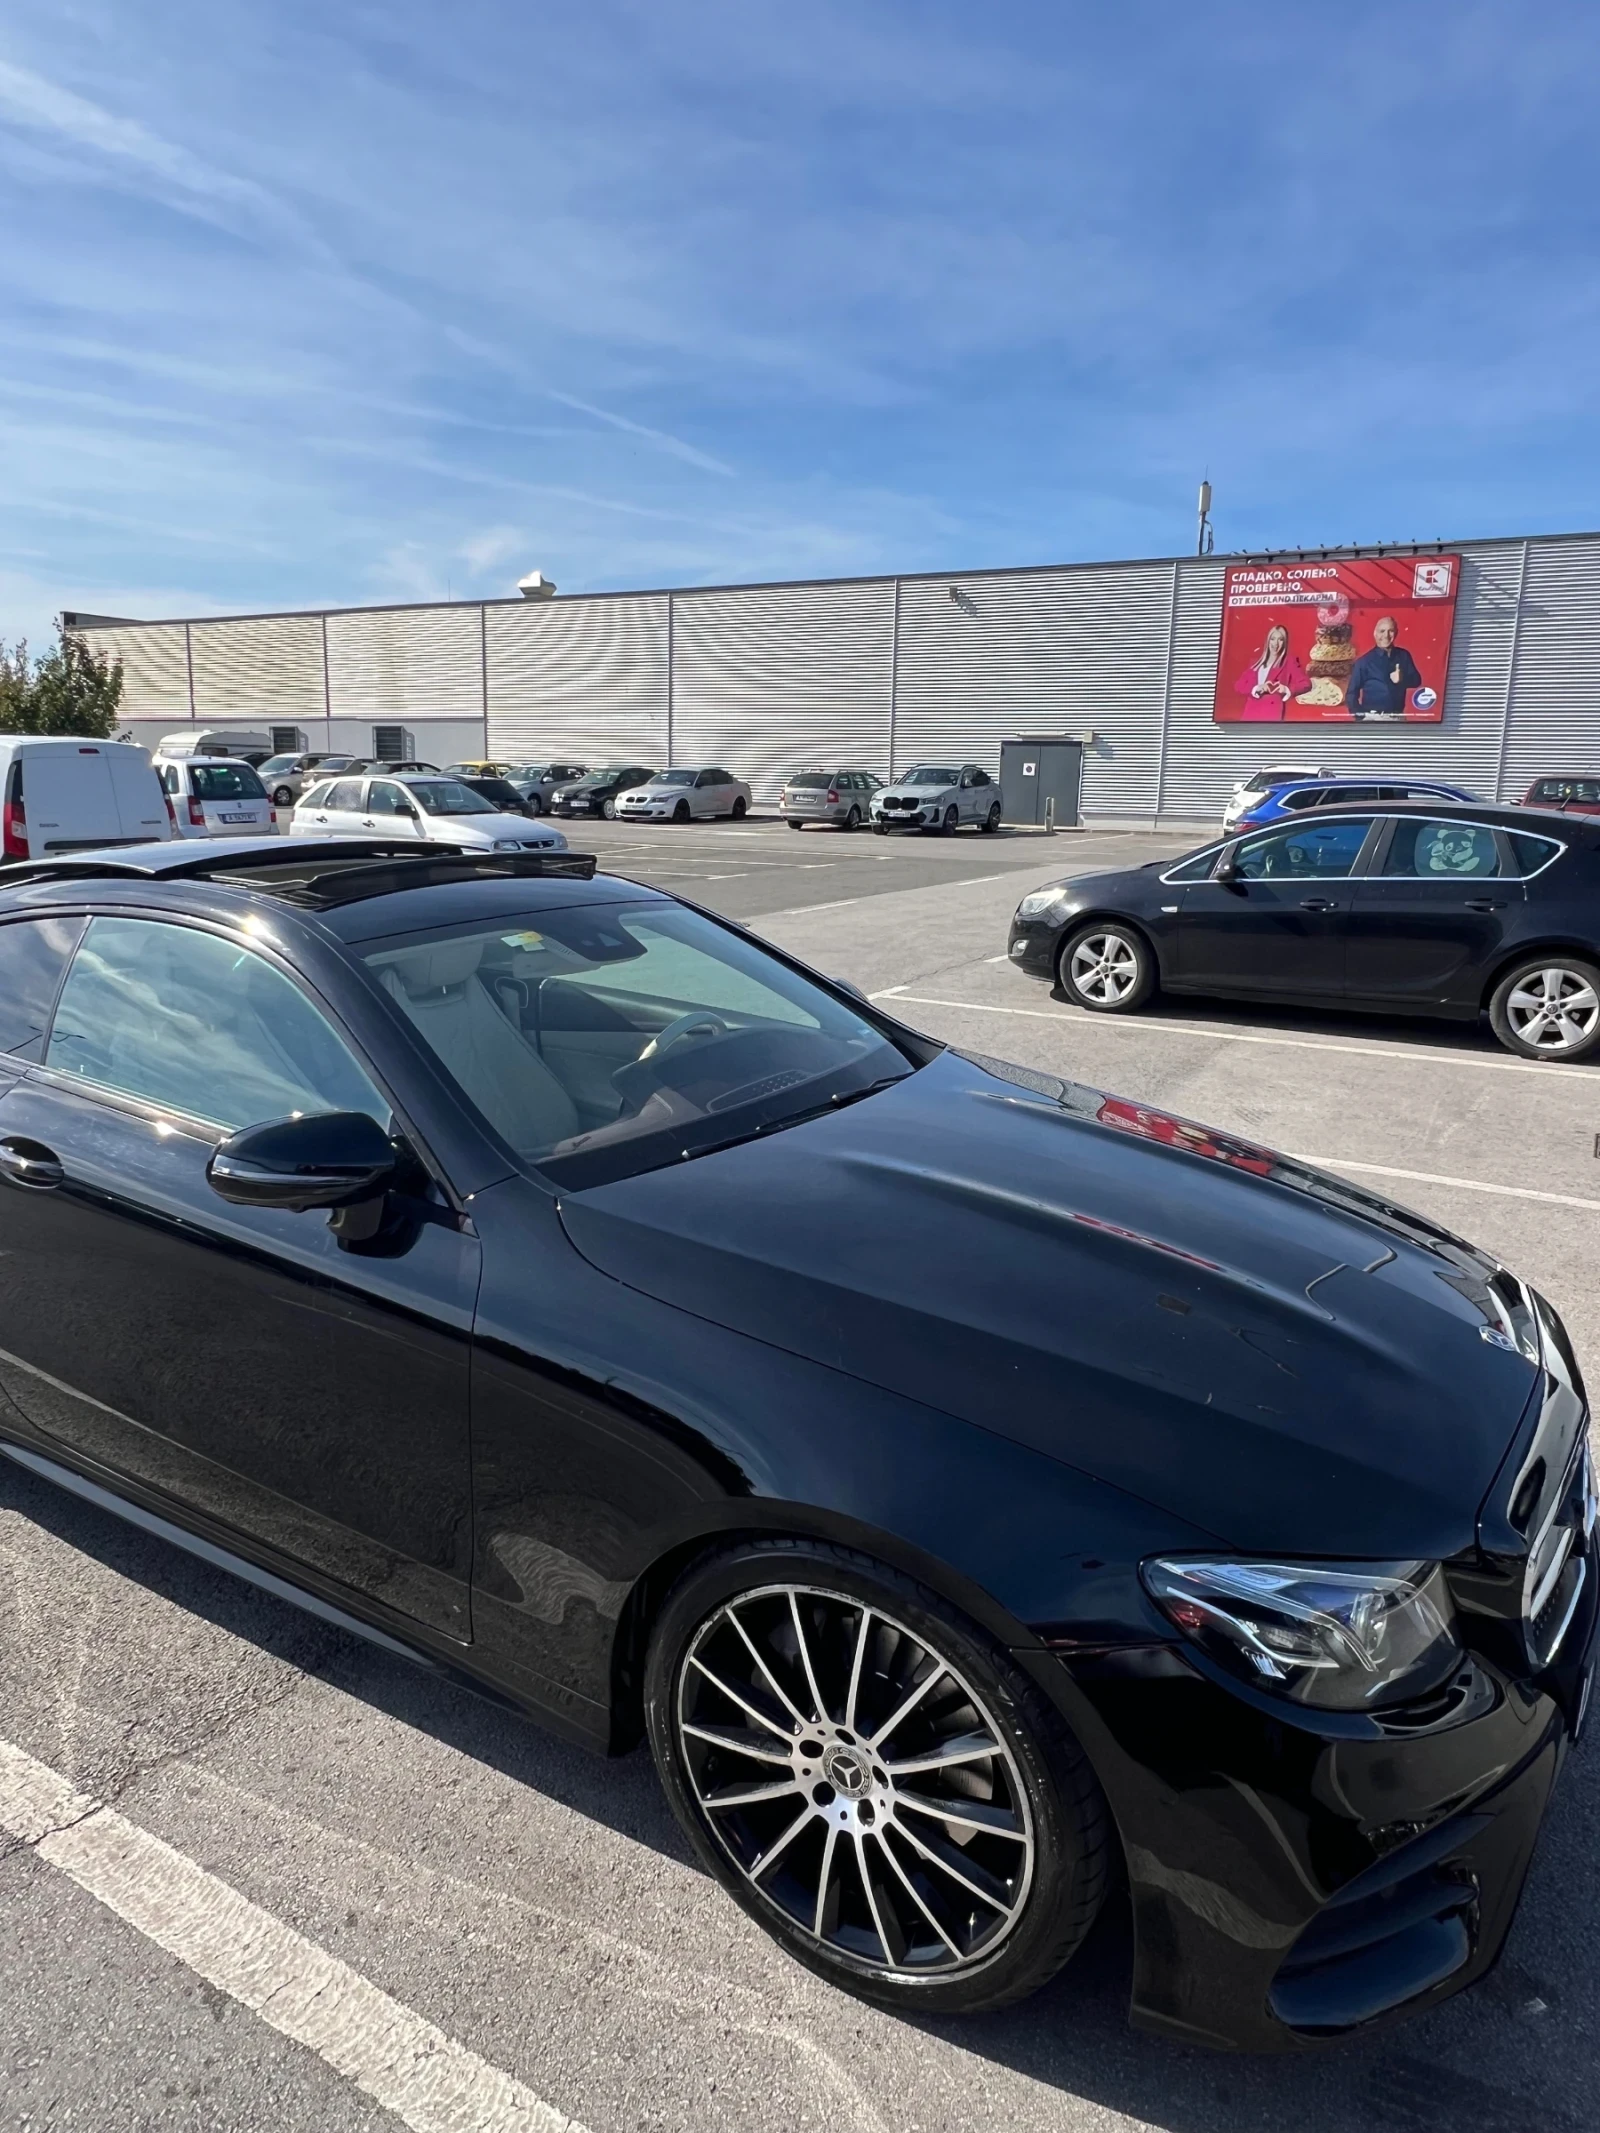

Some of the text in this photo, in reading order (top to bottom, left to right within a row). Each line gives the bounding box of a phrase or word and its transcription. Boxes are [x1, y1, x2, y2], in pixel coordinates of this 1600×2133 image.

[1231, 568, 1339, 582] СЛАДКО. СОЛЕНО.
[1230, 582, 1303, 594] ПРОВЕРЕНО.
[1244, 595, 1291, 604] KAUFLAND
